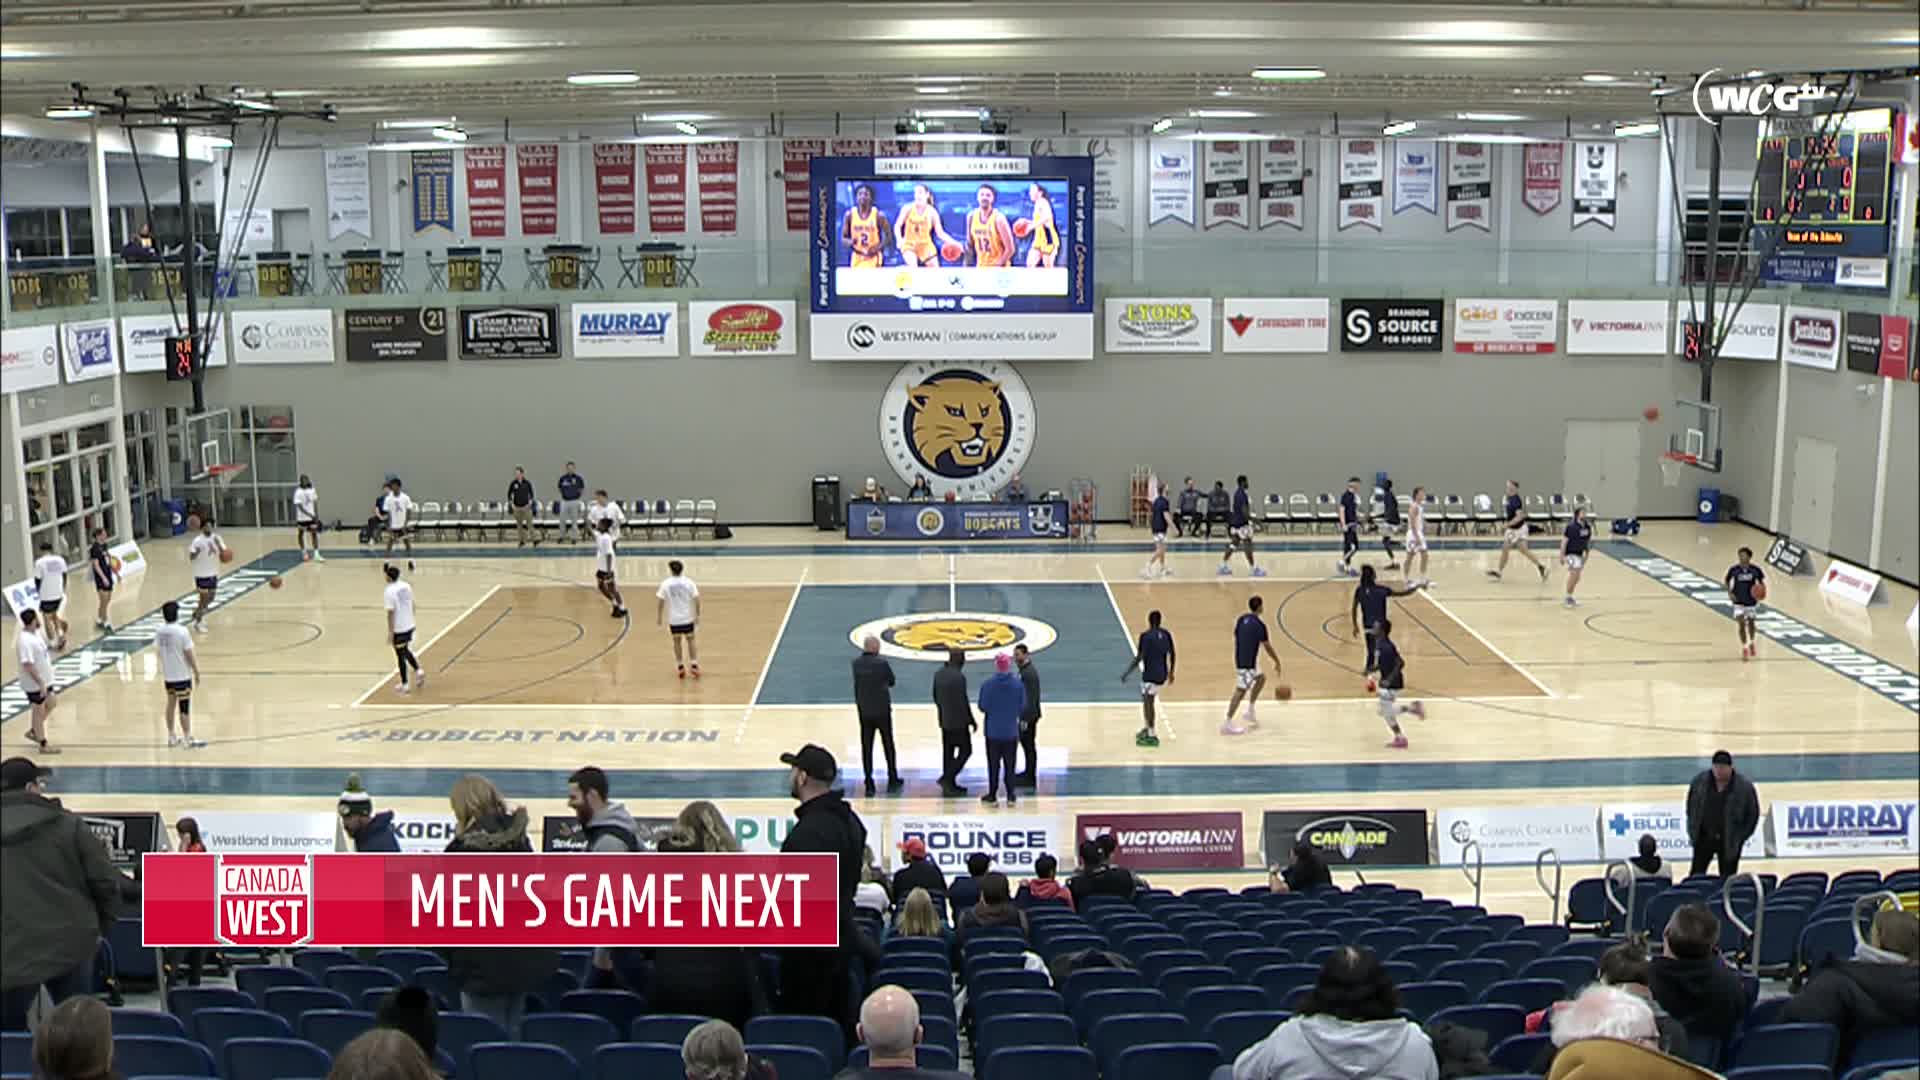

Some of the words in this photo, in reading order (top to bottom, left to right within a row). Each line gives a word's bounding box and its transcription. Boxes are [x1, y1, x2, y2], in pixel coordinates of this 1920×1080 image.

[1126, 303, 1193, 320] LYONS
[1388, 308, 1430, 317] BRANDON
[427, 311, 444, 327] 21
[579, 312, 672, 337] MURRAY
[1307, 318, 1326, 328] TIRE
[1377, 319, 1438, 333] SOURCE
[881, 332, 940, 342] WESTMAN
[949, 331, 1026, 342] COMMUNICATIONS
[1028, 331, 1057, 341] GROUP
[1382, 335, 1399, 344] FOR
[1401, 335, 1432, 344] SPORTS
[887, 414, 933, 487] BRANDN
[964, 517, 1021, 530] BOBCATS
[555, 729, 721, 742] NATION
[1633, 818, 1681, 830] BLUE
[1787, 804, 1914, 836] MURRAY
[211, 833, 269, 847] Westland
[271, 833, 333, 847] Insurance
